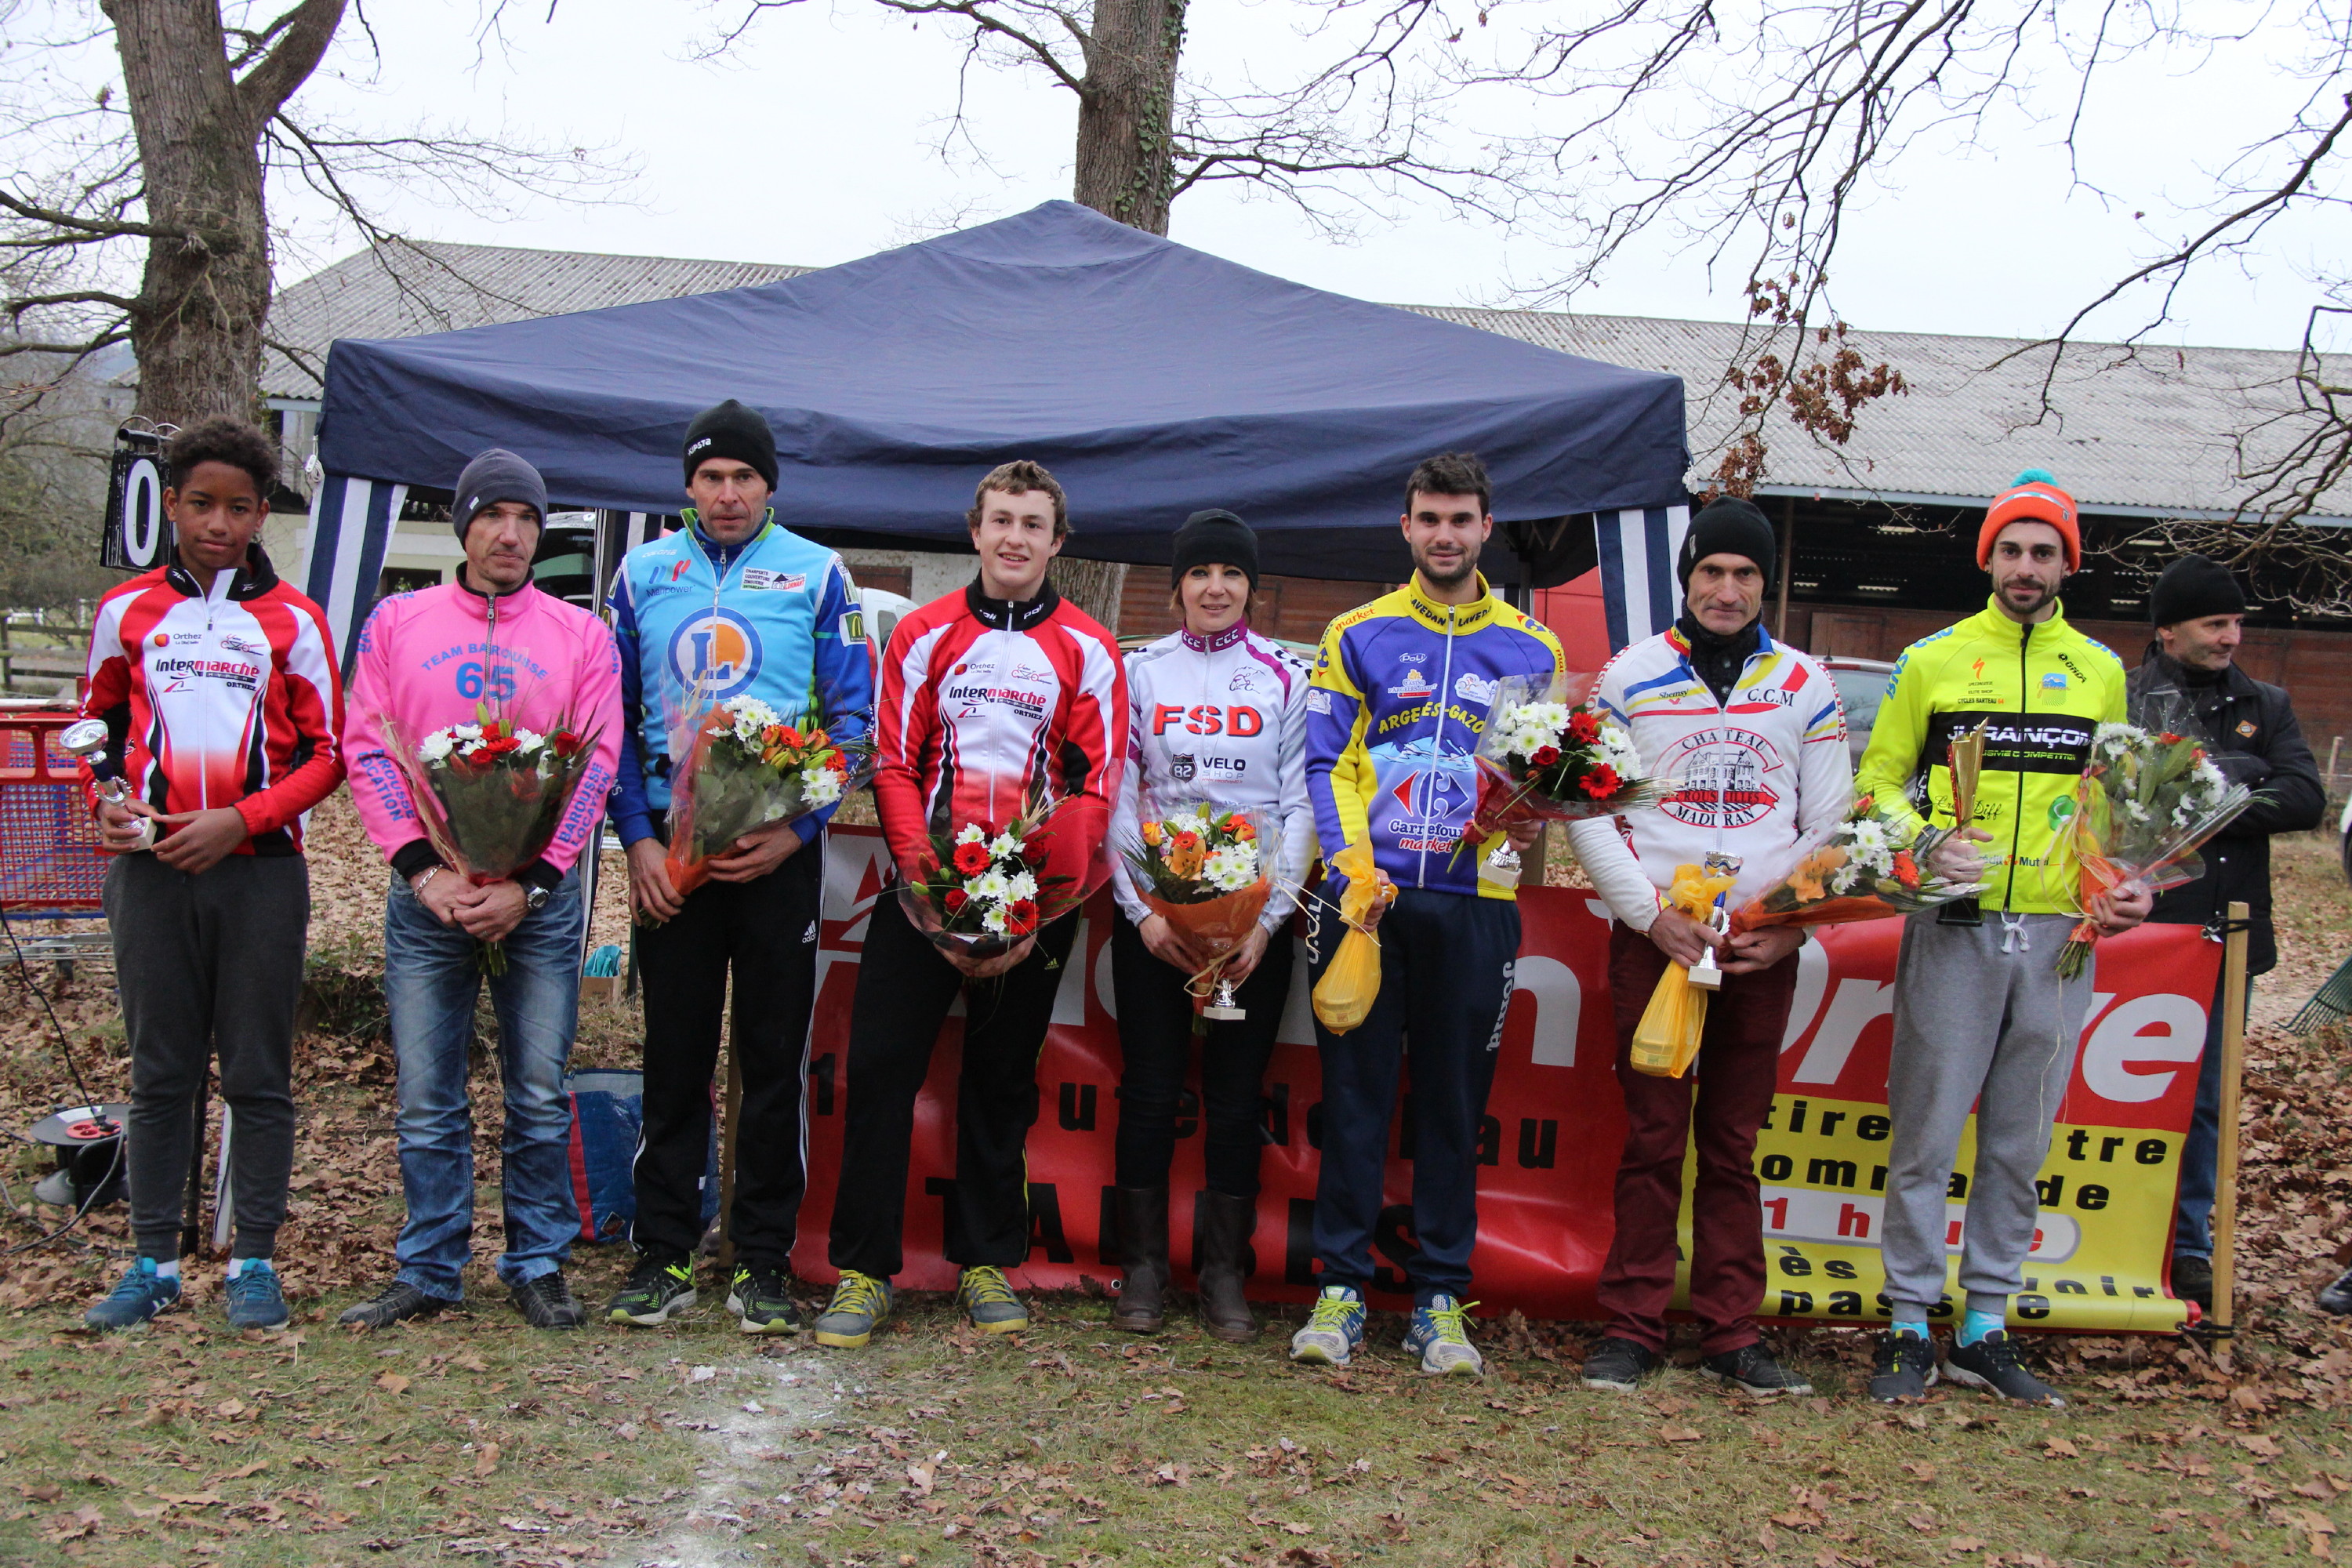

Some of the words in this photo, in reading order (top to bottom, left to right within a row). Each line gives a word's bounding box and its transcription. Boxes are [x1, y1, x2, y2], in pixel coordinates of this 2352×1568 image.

[646, 586, 693, 597] Manpower
[1335, 608, 1376, 633] market
[1457, 605, 1492, 627] LAVED
[421, 646, 463, 671] TEAM
[468, 643, 548, 681] BAROUSSE
[227, 681, 257, 691] ORTHEZ
[456, 662, 517, 702] 65
[1658, 688, 1689, 699] Shemsy
[1014, 709, 1044, 720] ORTHEZ
[1152, 702, 1264, 737] FSD
[1174, 765, 1192, 778] 82
[1203, 757, 1247, 771] VELO
[1202, 770, 1244, 779] SHOP
[557, 762, 603, 843] BAROUSSE
[571, 771, 612, 848] LOCATION
[1973, 800, 2003, 820] Diff
[1674, 805, 1755, 826] MADIRAN
[1399, 837, 1453, 853] market
[1763, 1181, 1788, 1229] 1
